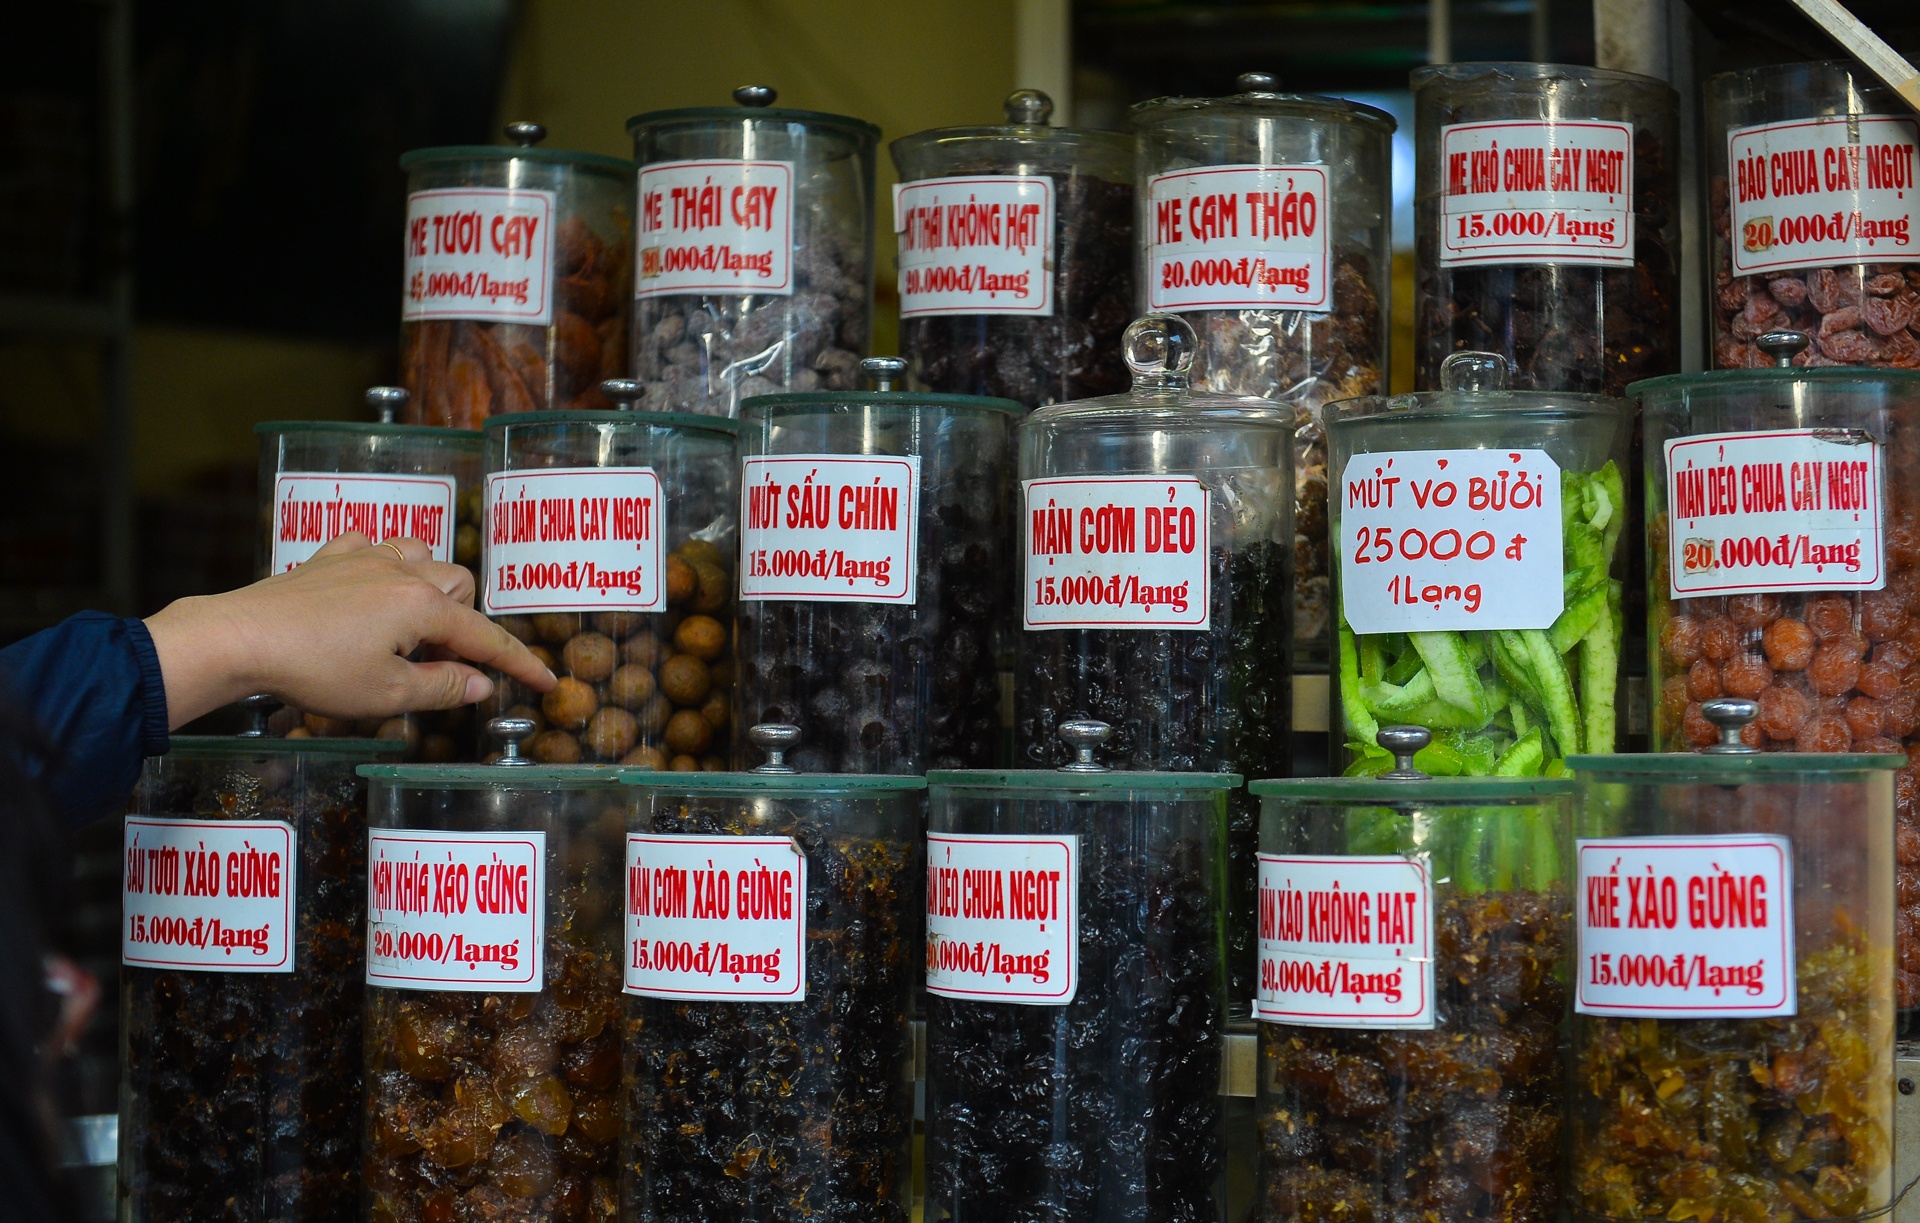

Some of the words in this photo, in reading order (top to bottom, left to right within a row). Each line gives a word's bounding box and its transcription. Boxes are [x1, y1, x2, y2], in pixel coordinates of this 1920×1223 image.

[1450, 152, 1467, 196] ME
[1471, 140, 1499, 193] KHÔ
[1504, 148, 1545, 190] CHUA
[1552, 148, 1582, 191] CAY
[1586, 148, 1625, 204] NGỌT
[1771, 149, 1820, 198] CHUA
[1824, 146, 1860, 192] CAY
[1866, 144, 1914, 199] NGỌT
[643, 191, 663, 232] ME
[671, 176, 722, 232] THÁI
[731, 186, 778, 232] CAY
[918, 195, 942, 253] THÁI
[947, 194, 1000, 253] KHÔNG
[1006, 203, 1040, 255] HẠT
[1157, 199, 1182, 244] ME
[1190, 193, 1238, 242] CAM
[1246, 178, 1316, 242] THẢO
[1456, 212, 1615, 245] 15.000/lạng
[1745, 211, 1910, 246] 20.000đ/lạng
[409, 217, 427, 257] ME
[434, 210, 483, 255] TƯƠI
[490, 214, 539, 260] CAY
[1162, 258, 1310, 294] 20.000đ/lạng
[749, 472, 782, 530] MỨT
[786, 469, 832, 529] SẤU
[838, 477, 898, 531] CHÍN
[1409, 458, 1456, 508] VỎ
[1676, 459, 1706, 529] MẬN
[1709, 445, 1738, 516] DẺO
[1741, 464, 1786, 514] CHUA
[1790, 462, 1824, 512] CAY
[1827, 460, 1869, 521] NGỌT
[280, 485, 299, 542] SẤU
[300, 501, 323, 543] BAO
[326, 483, 343, 541] TỬ
[344, 502, 377, 543] CHUA
[382, 503, 408, 541] CAY
[493, 489, 510, 546] SẤU
[511, 486, 537, 544] DẦM
[540, 498, 575, 543] CHUA
[580, 497, 608, 541] CAY
[612, 497, 652, 550] NGỌT
[1032, 498, 1073, 566] MẬN
[1080, 506, 1136, 553] CƠM
[1144, 486, 1196, 554] DẺO
[748, 548, 891, 587] 15.000đ/lạng
[1355, 527, 1496, 563] 25000
[1684, 533, 1861, 573] 20.000đ/lạng
[498, 561, 642, 596] 15.000đ/lạng
[1035, 574, 1189, 614] 15.000đ/lạng
[127, 831, 144, 894] SẤU
[147, 845, 179, 896] TƯƠI
[183, 840, 220, 898] XÀO
[226, 840, 281, 898] GỪNG
[373, 849, 392, 921] MẬN
[396, 851, 429, 918] KHÍA
[433, 851, 469, 919] XÀO
[475, 852, 528, 914] GỪNG
[629, 857, 651, 927] MẬN
[653, 864, 687, 918] CƠM
[693, 859, 731, 919] XÀO
[736, 858, 792, 921] GỪNG
[939, 846, 959, 918] DẺO
[962, 868, 1005, 920] CHUA
[1009, 870, 1060, 932] NGỌT
[1278, 879, 1303, 942] XÀO
[1308, 880, 1370, 945] KHÔNG
[1378, 892, 1417, 957] HẠT
[1587, 857, 1620, 930] KHẾ
[1627, 864, 1678, 930] XÀO
[1688, 863, 1768, 929] GỪNG
[129, 915, 270, 955] 15.000đ/lạng
[375, 931, 519, 971] 20.000/lạng
[631, 938, 780, 984] 15.000đ/lạng
[1589, 952, 1766, 996] 15.000đ/lạng
